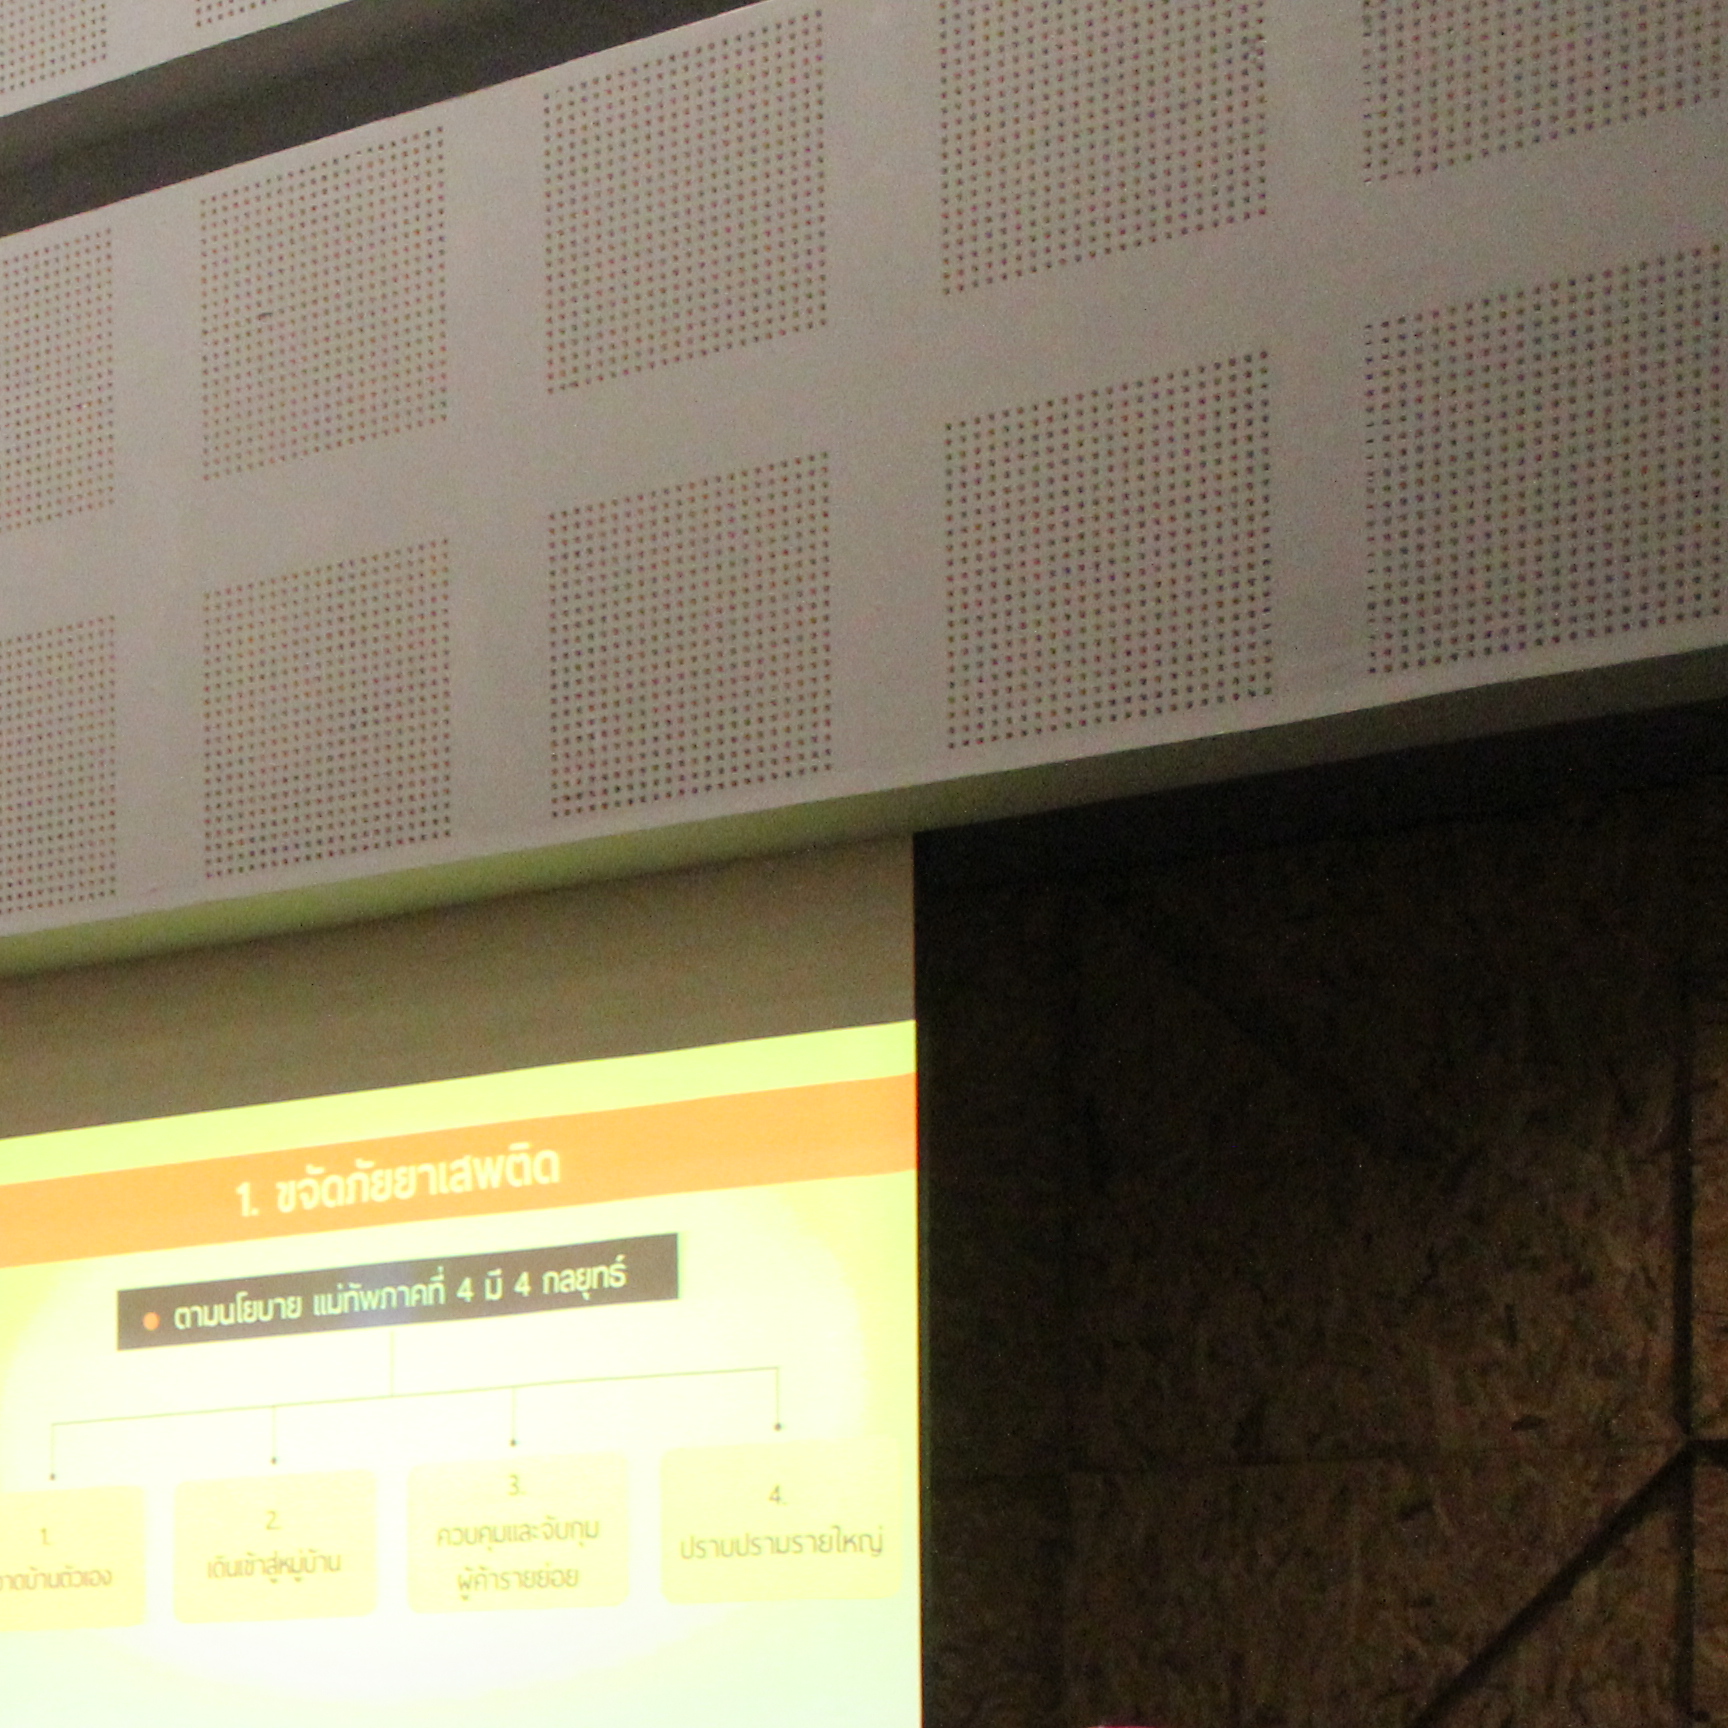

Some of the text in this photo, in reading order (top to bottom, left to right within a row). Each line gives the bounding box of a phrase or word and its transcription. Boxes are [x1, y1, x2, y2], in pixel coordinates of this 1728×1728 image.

[235, 1141, 561, 1217] 1. ขจัดภัยยาเสพติด
[174, 1252, 628, 1331] ตามนโยบาย แม่ทัพภาคที่ 4 มี 4 กลยุทธ์
[435, 1513, 601, 1552] ควบคุมและจับกุม
[679, 1522, 884, 1561] ปราบปรามรายใหญ่
